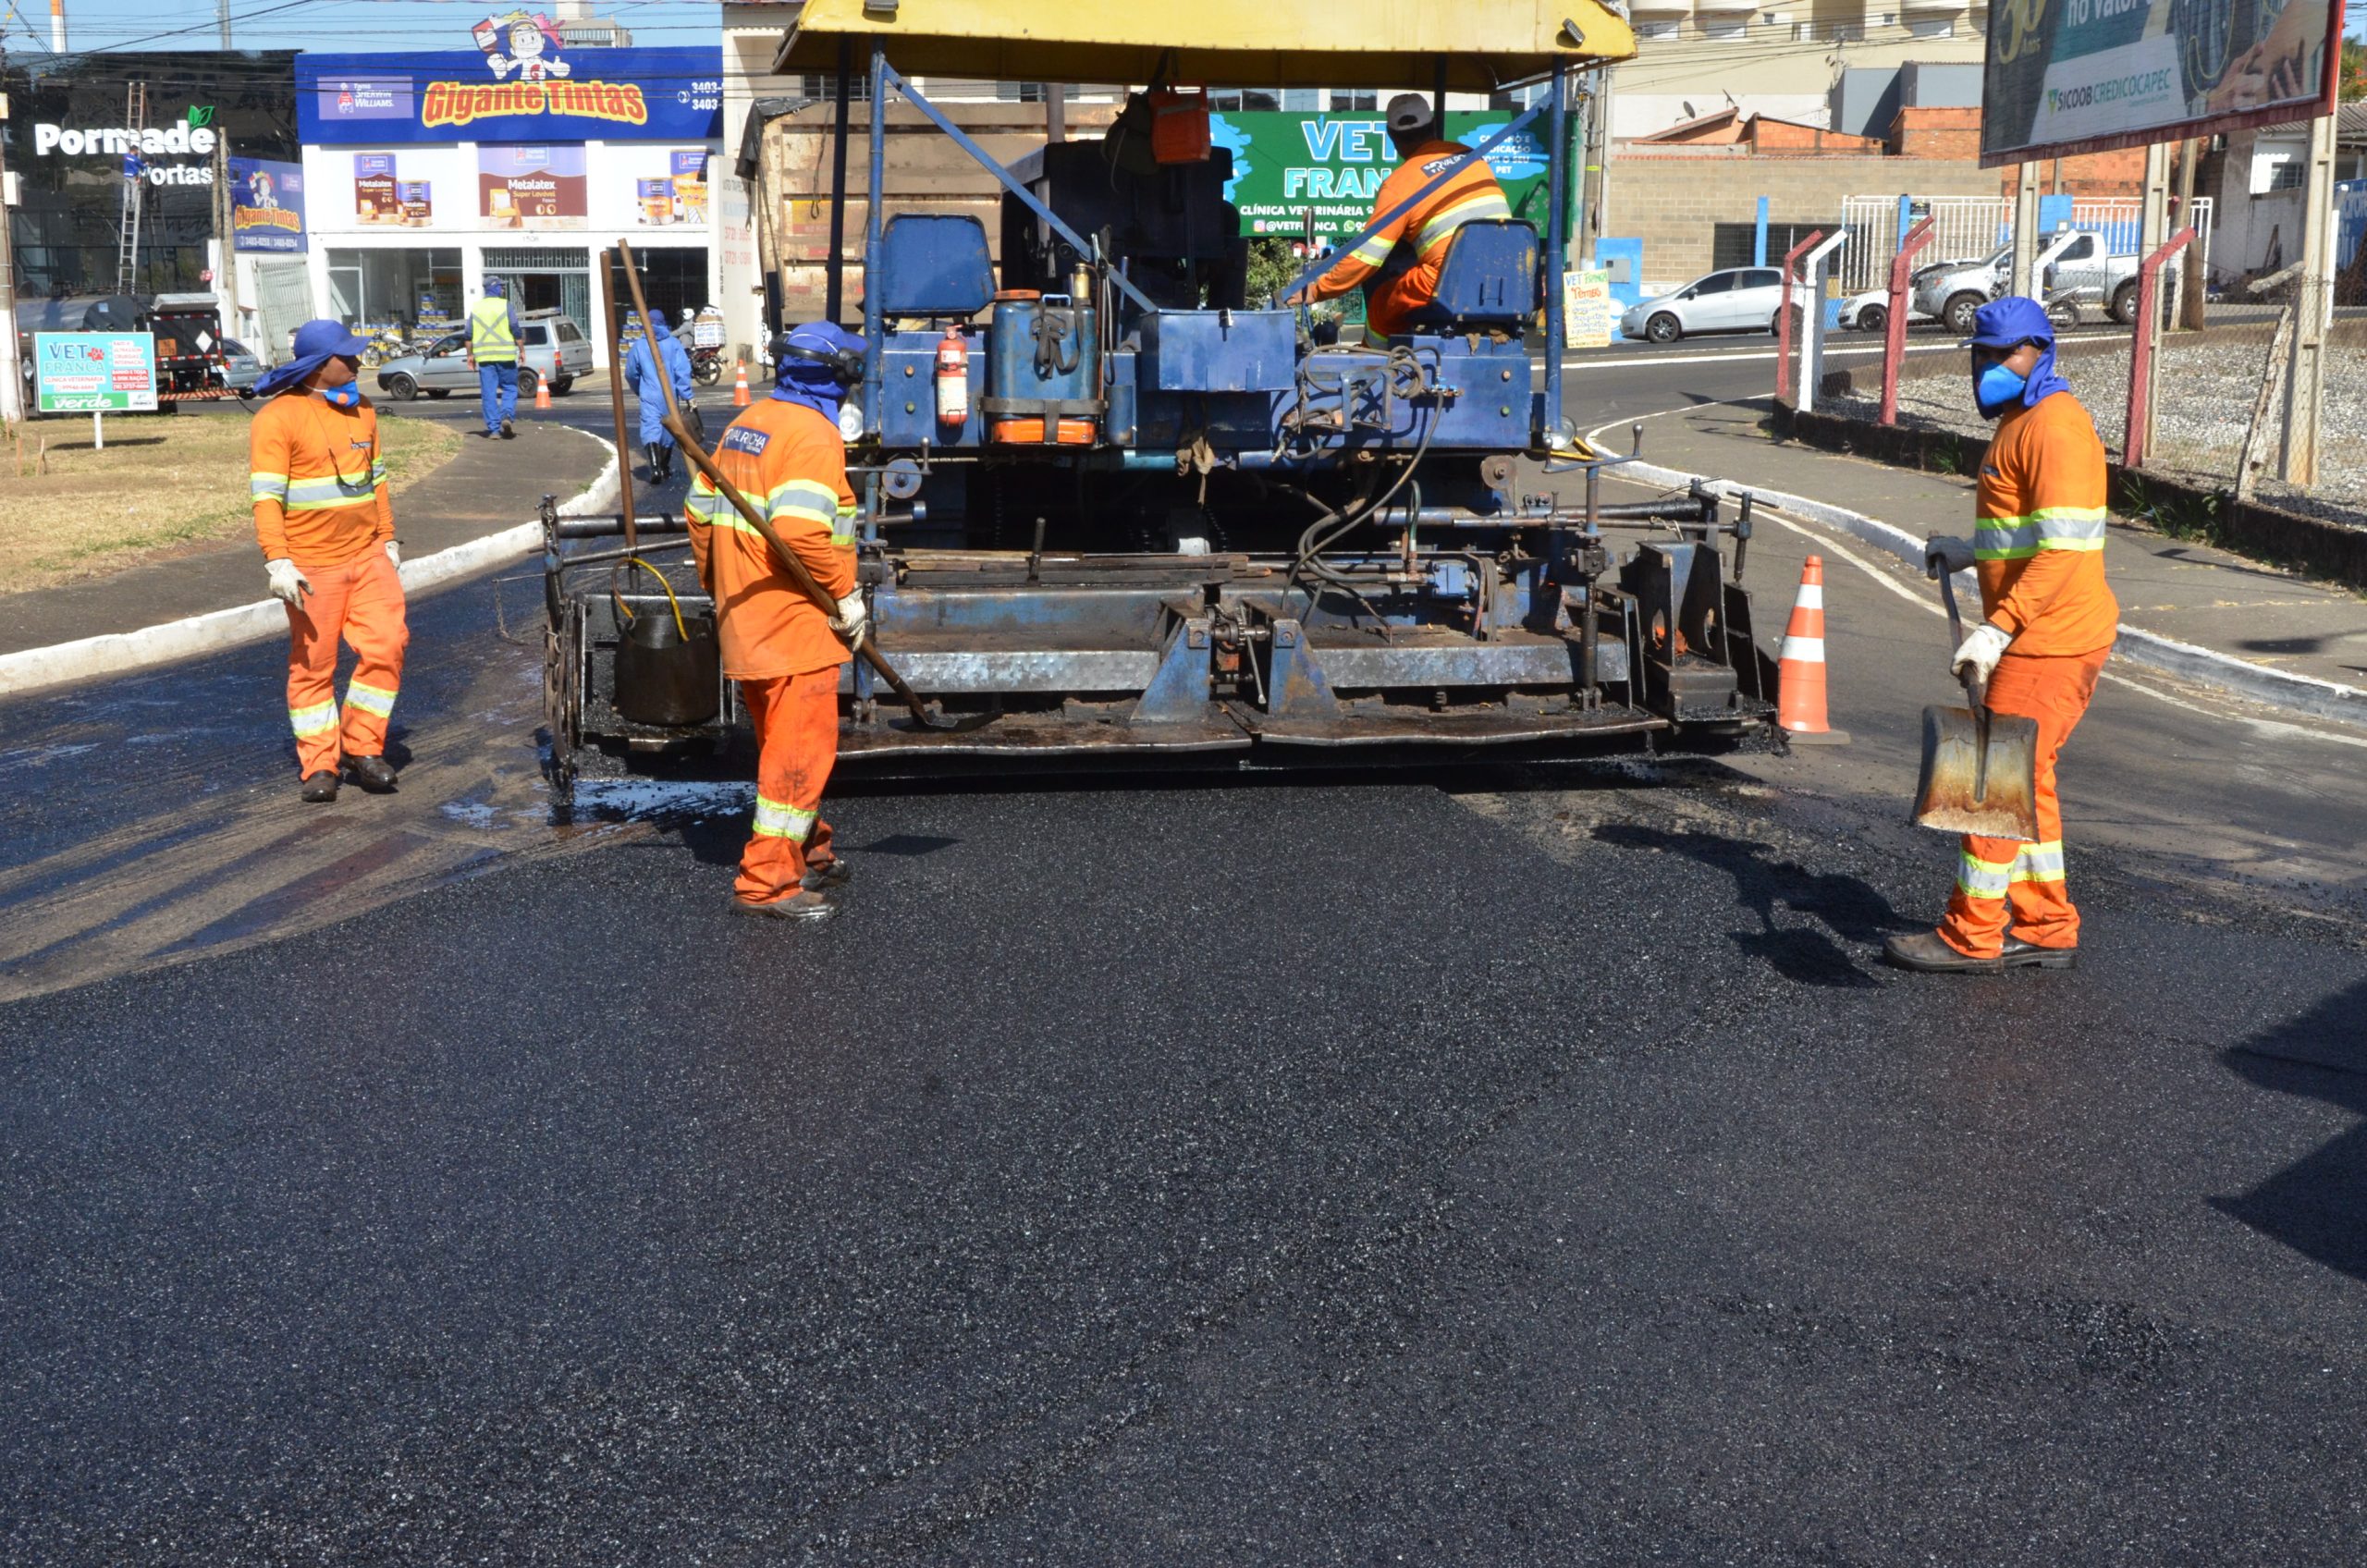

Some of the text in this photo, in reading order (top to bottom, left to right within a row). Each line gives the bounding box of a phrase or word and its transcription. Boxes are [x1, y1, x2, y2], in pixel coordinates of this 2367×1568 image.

[2058, 85, 2093, 111] SICOOB
[2093, 68, 2172, 104] CREDICOCAPEC
[423, 80, 646, 127] Gigante Tintas
[34, 119, 215, 155] Pormade
[1301, 120, 1398, 162] VET
[1490, 145, 1531, 154] DICAÇÃO
[145, 164, 214, 186] ortas
[1496, 165, 1513, 174] PET
[508, 178, 557, 190] Metalatex
[1284, 167, 1392, 199] FRAN
[1240, 203, 1364, 216] CLÍNICA VETRINÁRIA
[1266, 220, 1338, 232] @VETFNCA
[1565, 273, 1582, 287] VET
[49, 343, 88, 359] VET
[54, 392, 112, 408] verde
